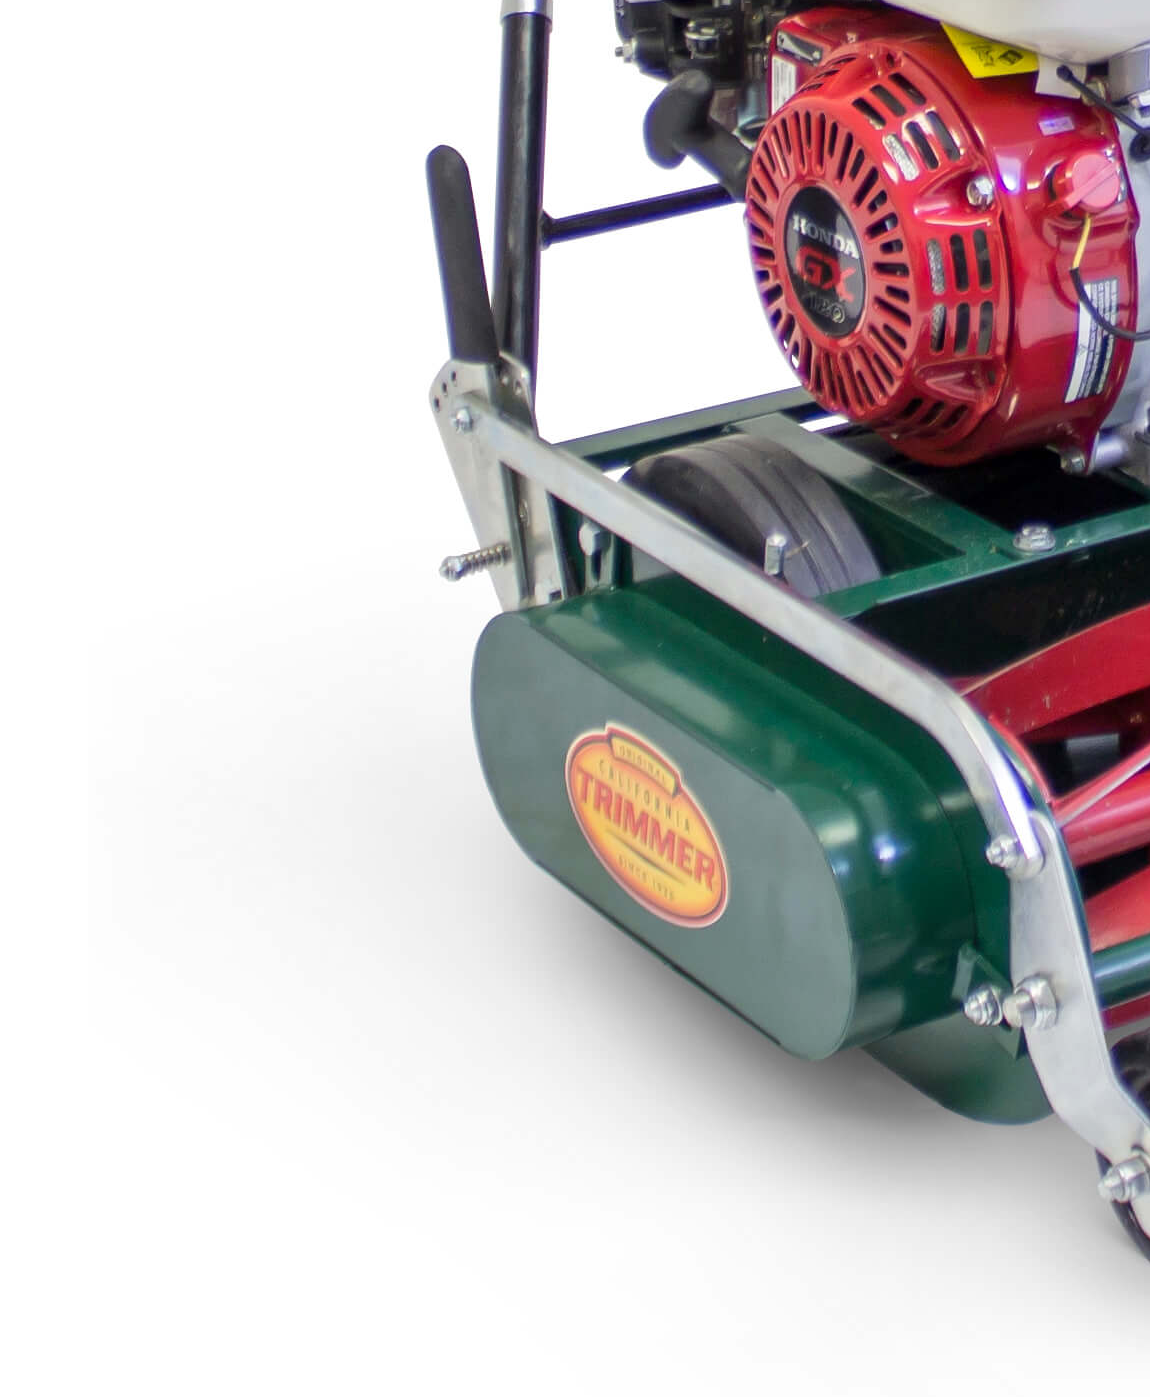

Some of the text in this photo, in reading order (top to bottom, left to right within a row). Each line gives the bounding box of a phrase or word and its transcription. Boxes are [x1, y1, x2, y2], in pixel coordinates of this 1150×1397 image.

[792, 214, 860, 260] HONDA
[796, 244, 856, 303] GX
[599, 759, 691, 833] CALIFORNIA
[577, 771, 715, 893] TRIMMER
